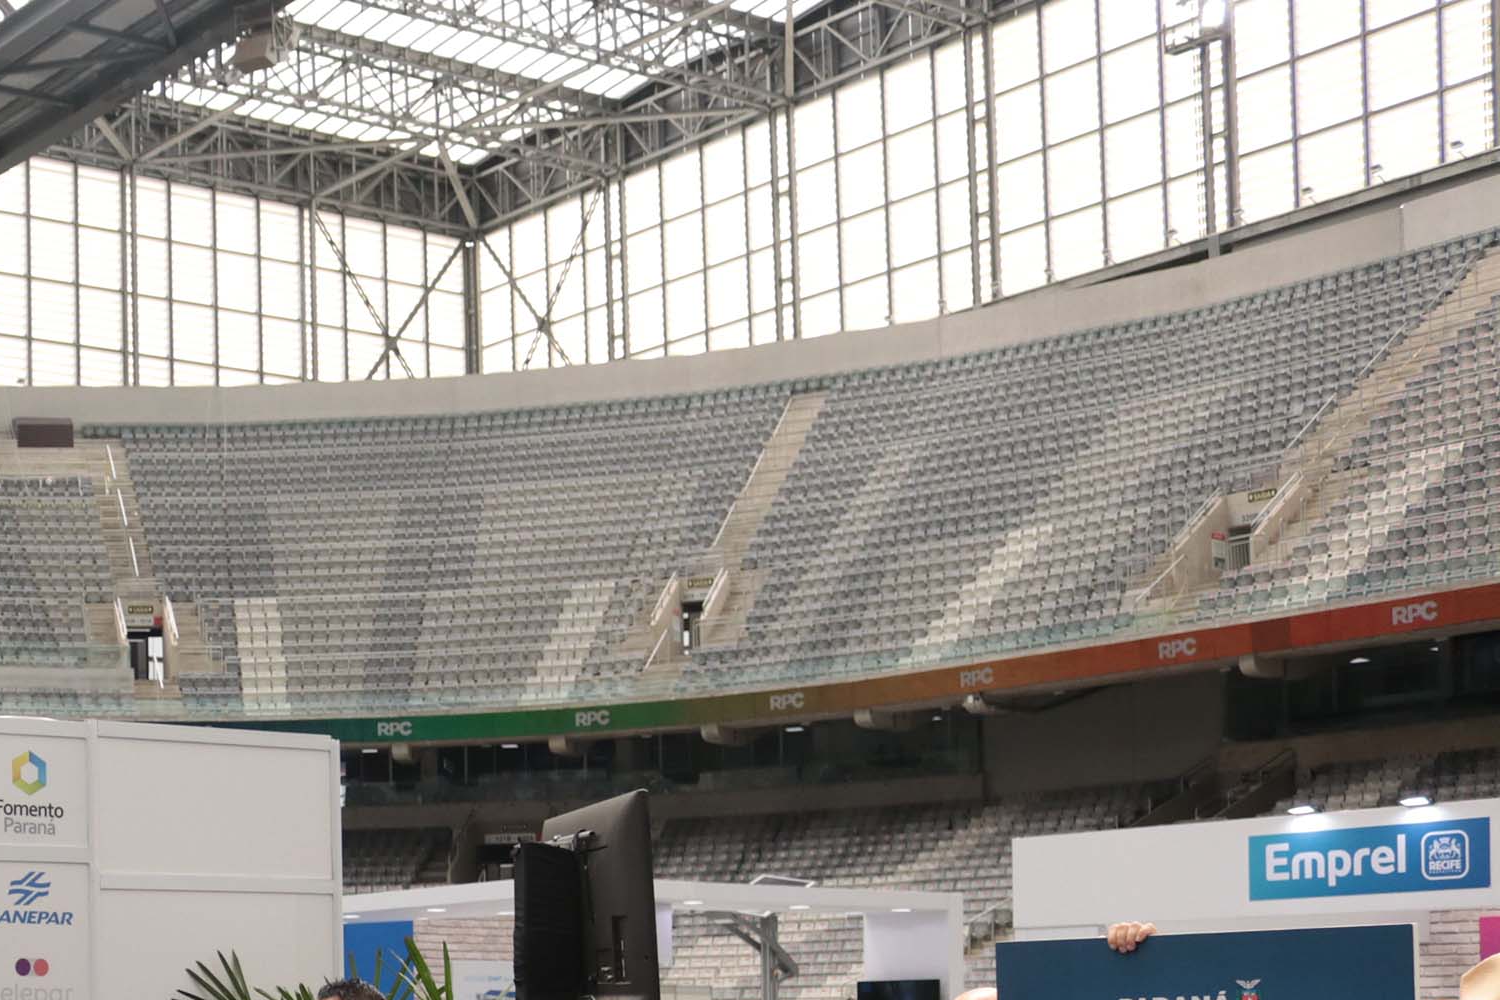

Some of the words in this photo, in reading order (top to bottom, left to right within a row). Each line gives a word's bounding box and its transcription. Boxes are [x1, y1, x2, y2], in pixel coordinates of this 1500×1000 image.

[1392, 601, 1438, 625] RPC
[1158, 638, 1196, 659] RPC
[960, 668, 993, 687] RPC
[770, 692, 804, 711] RPC
[575, 710, 610, 727] RPC
[377, 720, 412, 737] RPC
[3, 816, 56, 836] Paraná
[1265, 834, 1406, 887] Emprel
[1429, 859, 1461, 871] RECIFE
